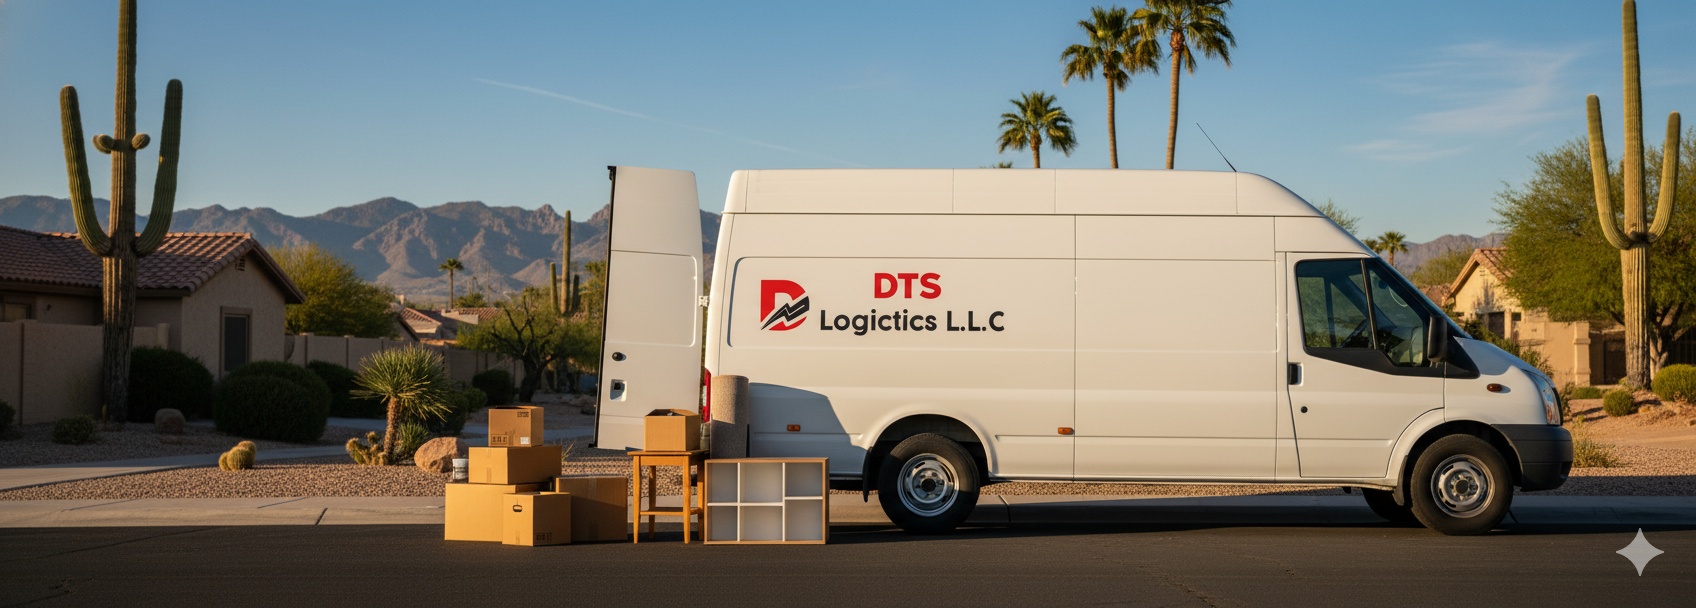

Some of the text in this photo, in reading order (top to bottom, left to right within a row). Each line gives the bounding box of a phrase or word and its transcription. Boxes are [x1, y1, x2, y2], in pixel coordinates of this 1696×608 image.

[874, 272, 942, 299] DTS
[820, 308, 1005, 336] Logictics L.L.C
